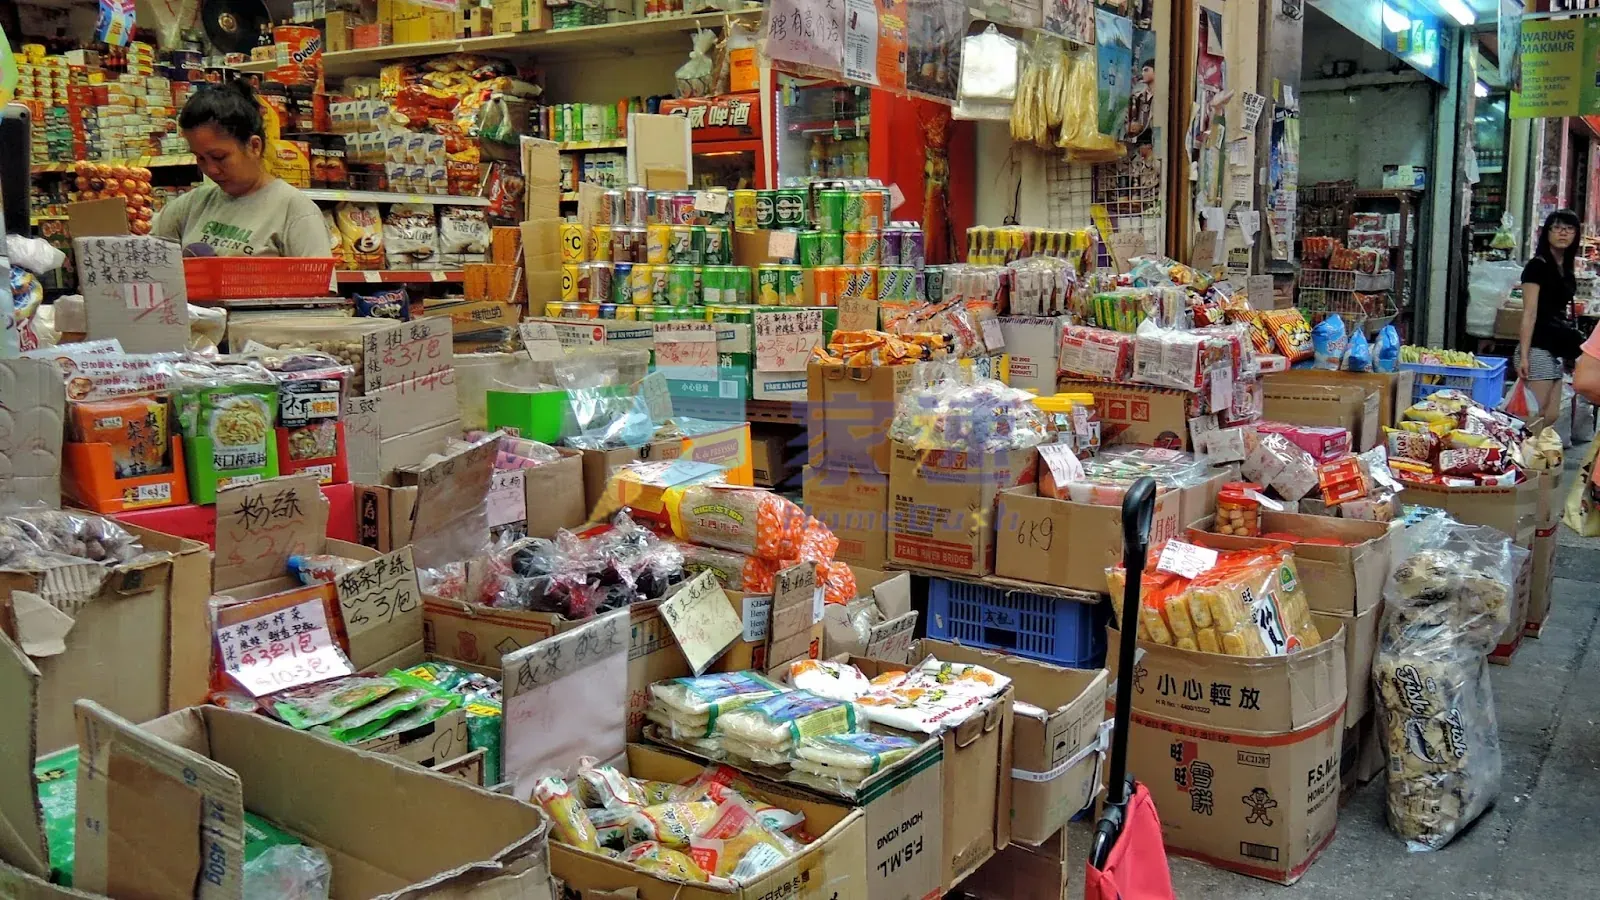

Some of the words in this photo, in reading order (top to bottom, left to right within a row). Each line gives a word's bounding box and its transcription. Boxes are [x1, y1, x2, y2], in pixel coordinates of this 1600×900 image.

[1521, 42, 1575, 54] MAKMUR
[1522, 30, 1575, 42] WARUNG
[200, 234, 254, 256] RACING
[897, 544, 919, 557] PEARL
[942, 551, 969, 565] BRIDGE
[1156, 673, 1262, 711] 小心輕放
[1397, 664, 1430, 715] Fish
[1446, 707, 1468, 760] Fish
[901, 810, 924, 834] HONG
[876, 826, 899, 851] KONG
